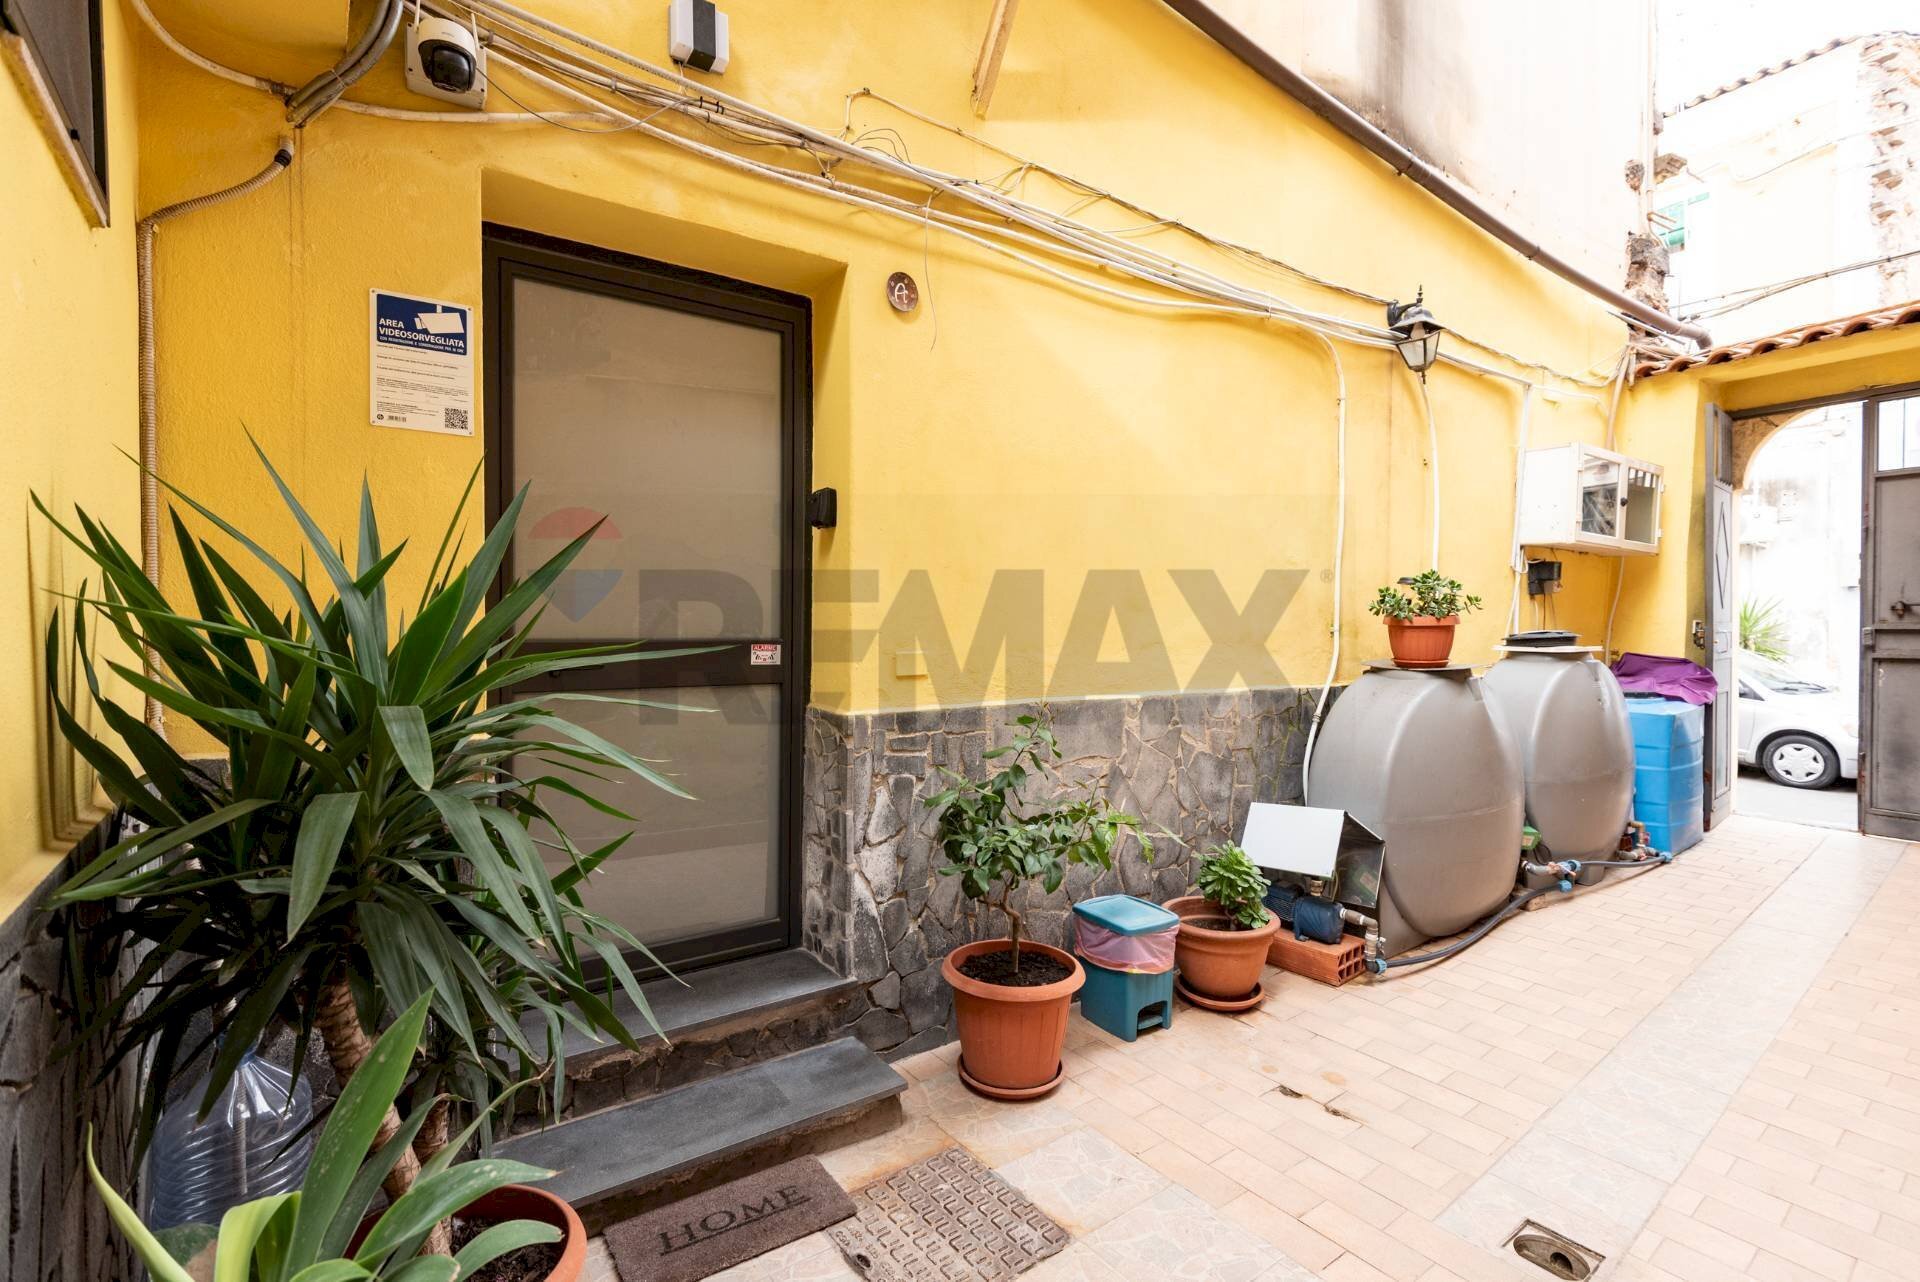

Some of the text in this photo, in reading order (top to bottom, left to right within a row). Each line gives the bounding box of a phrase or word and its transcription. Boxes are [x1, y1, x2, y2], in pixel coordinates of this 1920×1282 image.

[379, 318, 404, 328] AREA
[379, 327, 465, 348] VIDEOSORVEGLIATA
[658, 1185, 808, 1256] HOME
